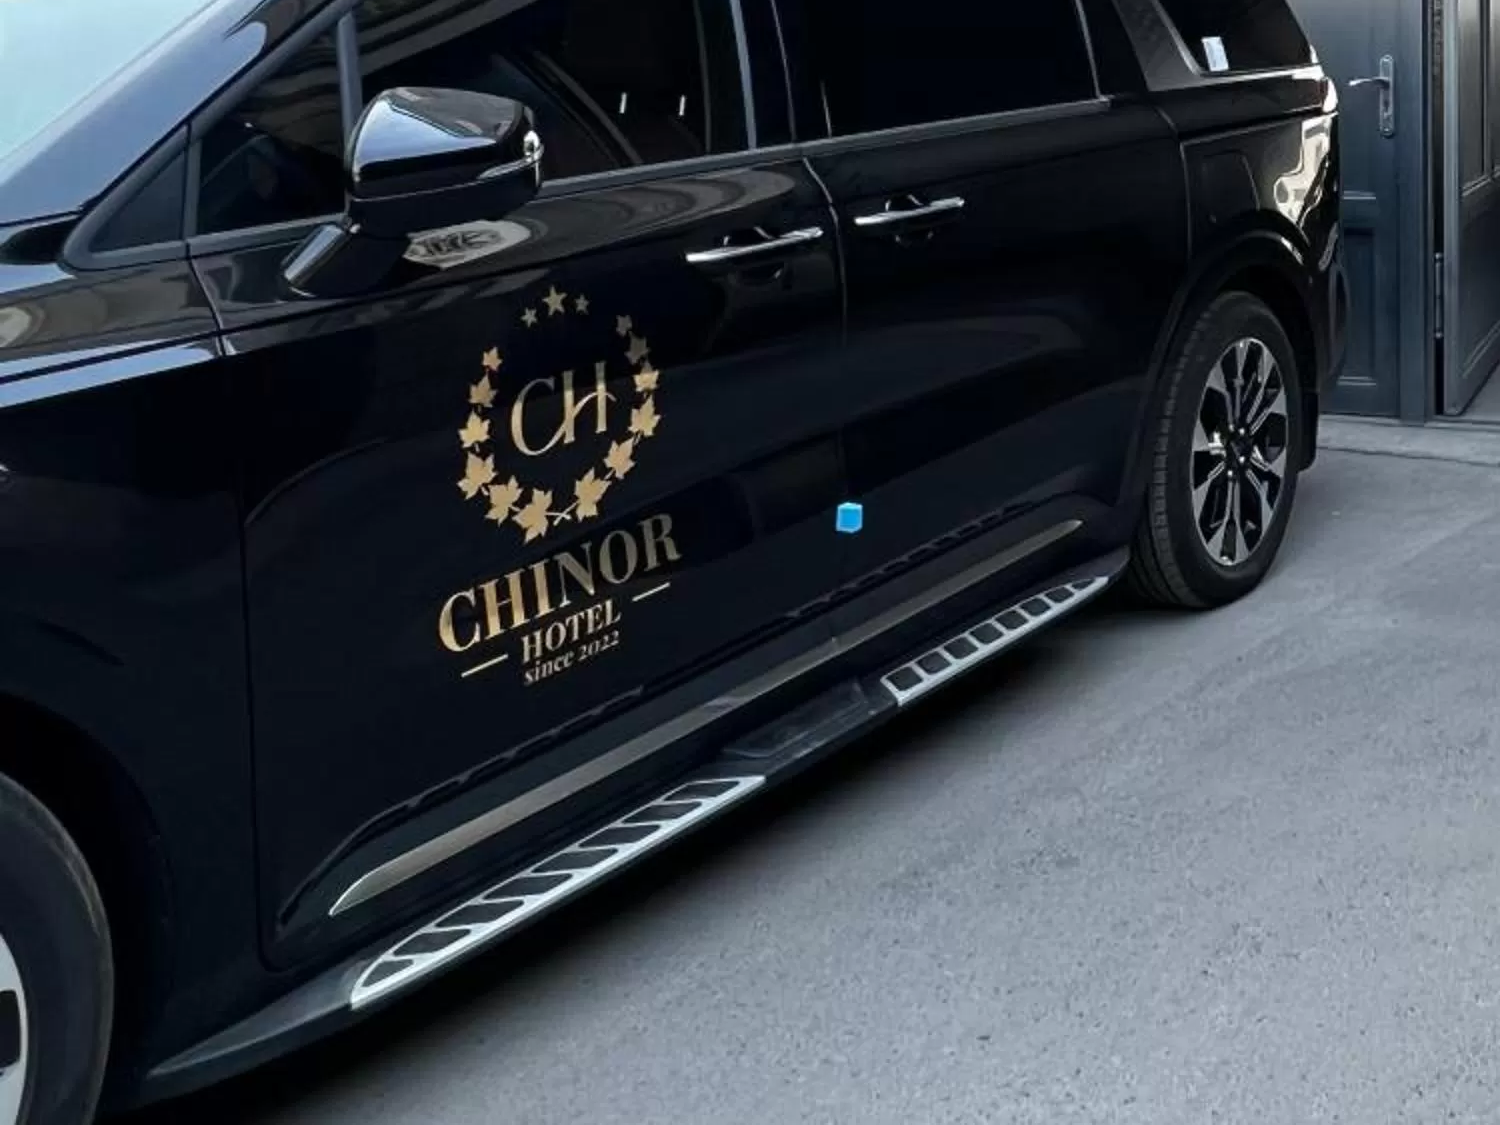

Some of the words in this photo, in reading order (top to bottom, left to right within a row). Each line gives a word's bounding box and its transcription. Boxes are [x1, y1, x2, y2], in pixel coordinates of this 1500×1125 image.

[438, 513, 681, 653] CHINOR
[521, 599, 621, 664] HOTEL
[524, 651, 574, 686] since
[578, 630, 619, 661] 2022
